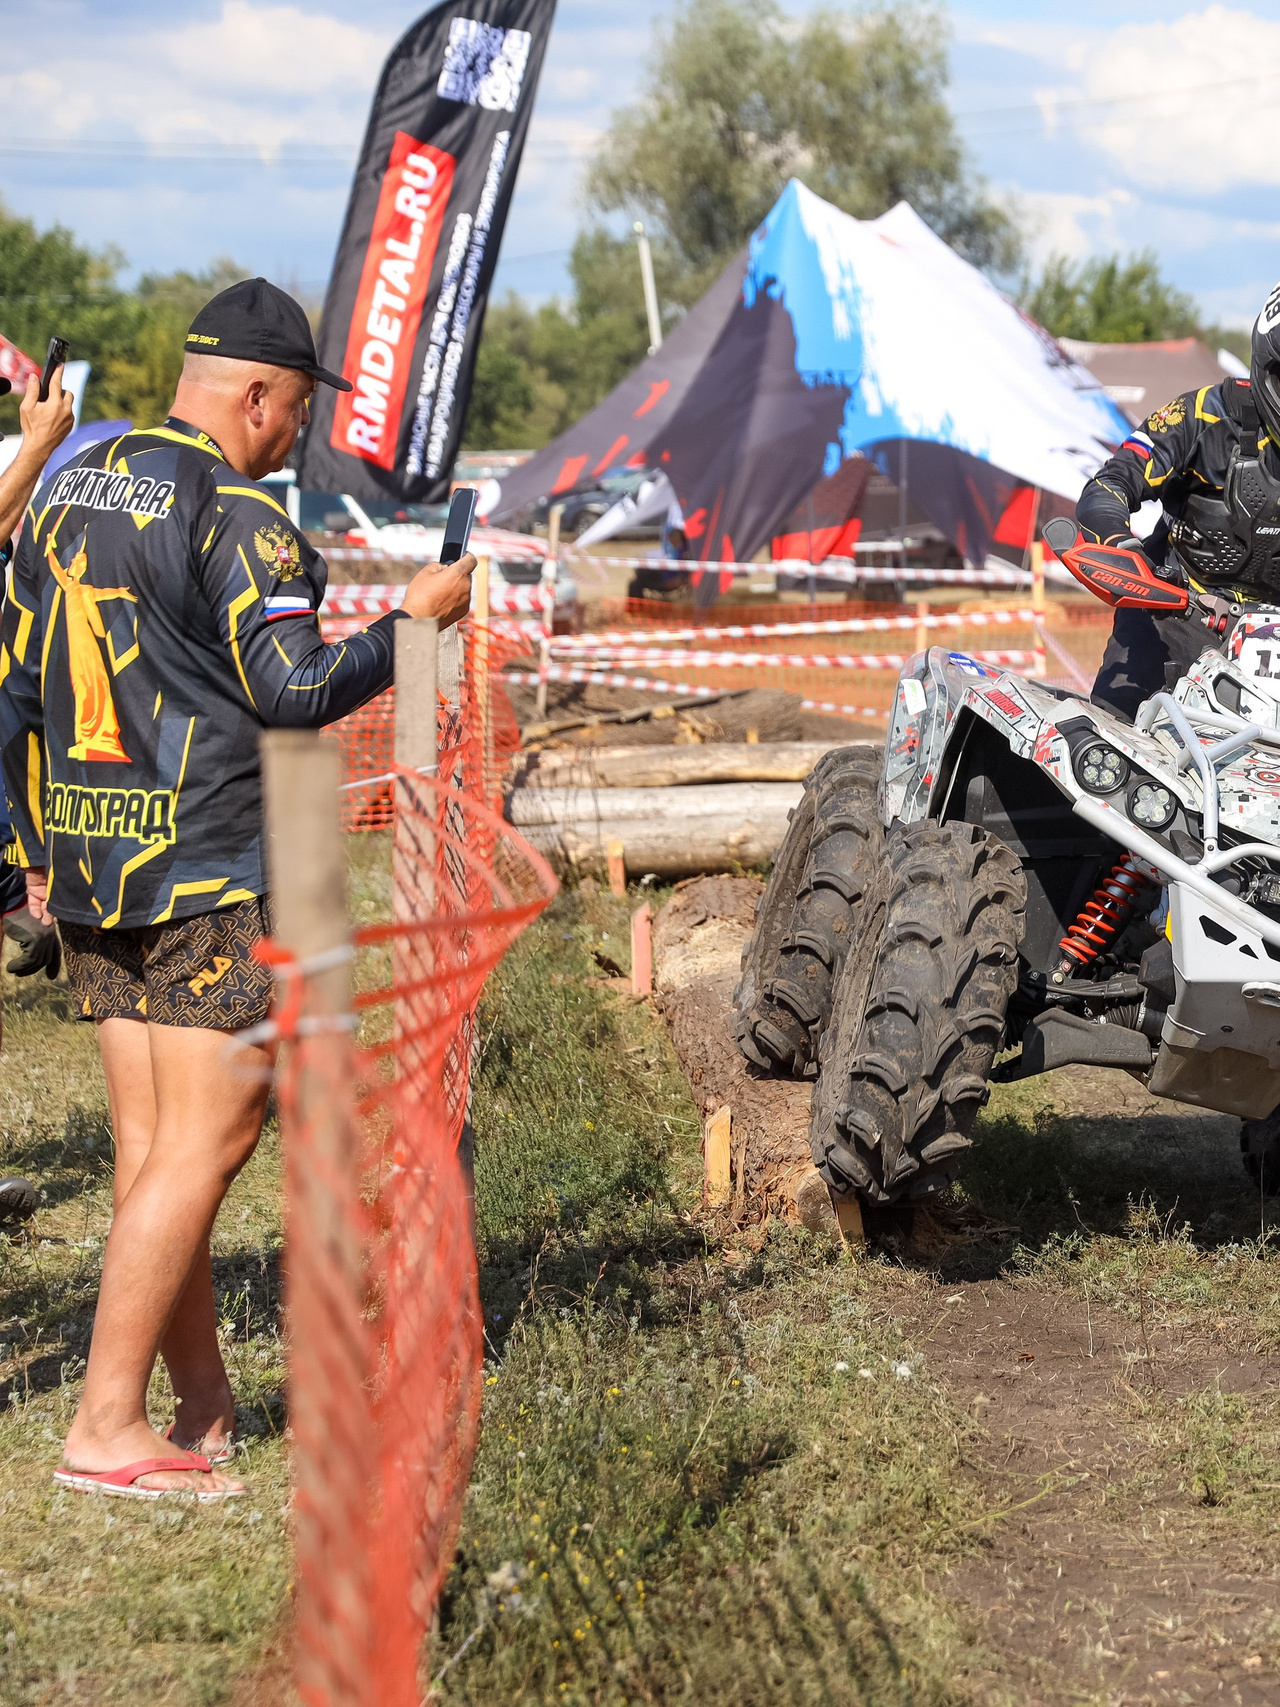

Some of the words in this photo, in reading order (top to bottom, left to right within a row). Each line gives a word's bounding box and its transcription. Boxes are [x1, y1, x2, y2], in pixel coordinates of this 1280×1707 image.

[345, 152, 439, 457] RMDETAL.RU
[421, 344, 443, 395] ЧАСТИ
[48, 467, 134, 511] КВИТКО
[122, 476, 176, 519] А.А.
[1091, 570, 1151, 596] can-am
[188, 955, 233, 997] FILA
